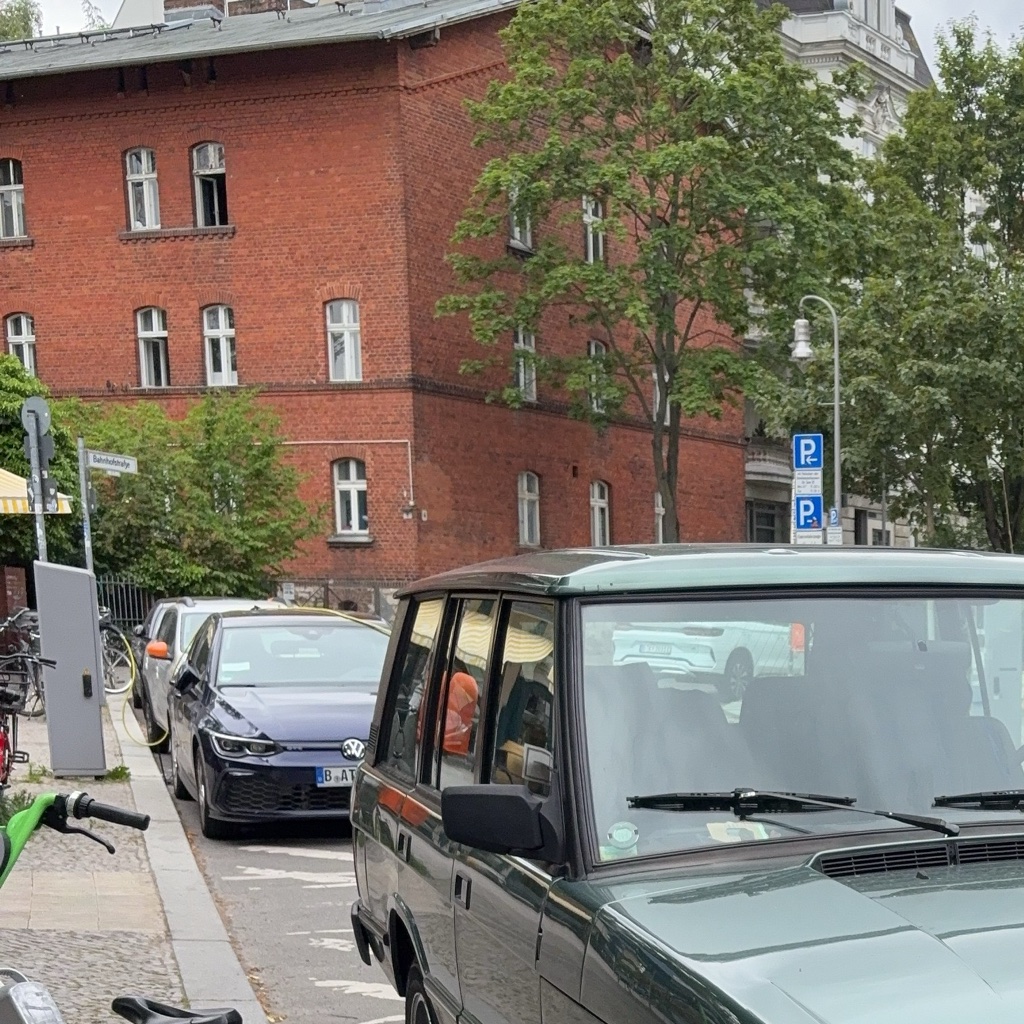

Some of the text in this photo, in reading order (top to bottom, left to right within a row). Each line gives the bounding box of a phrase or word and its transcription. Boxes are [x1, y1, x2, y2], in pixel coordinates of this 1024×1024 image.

[801, 439, 816, 465] P
[800, 500, 815, 526] P
[324, 769, 333, 782] B
